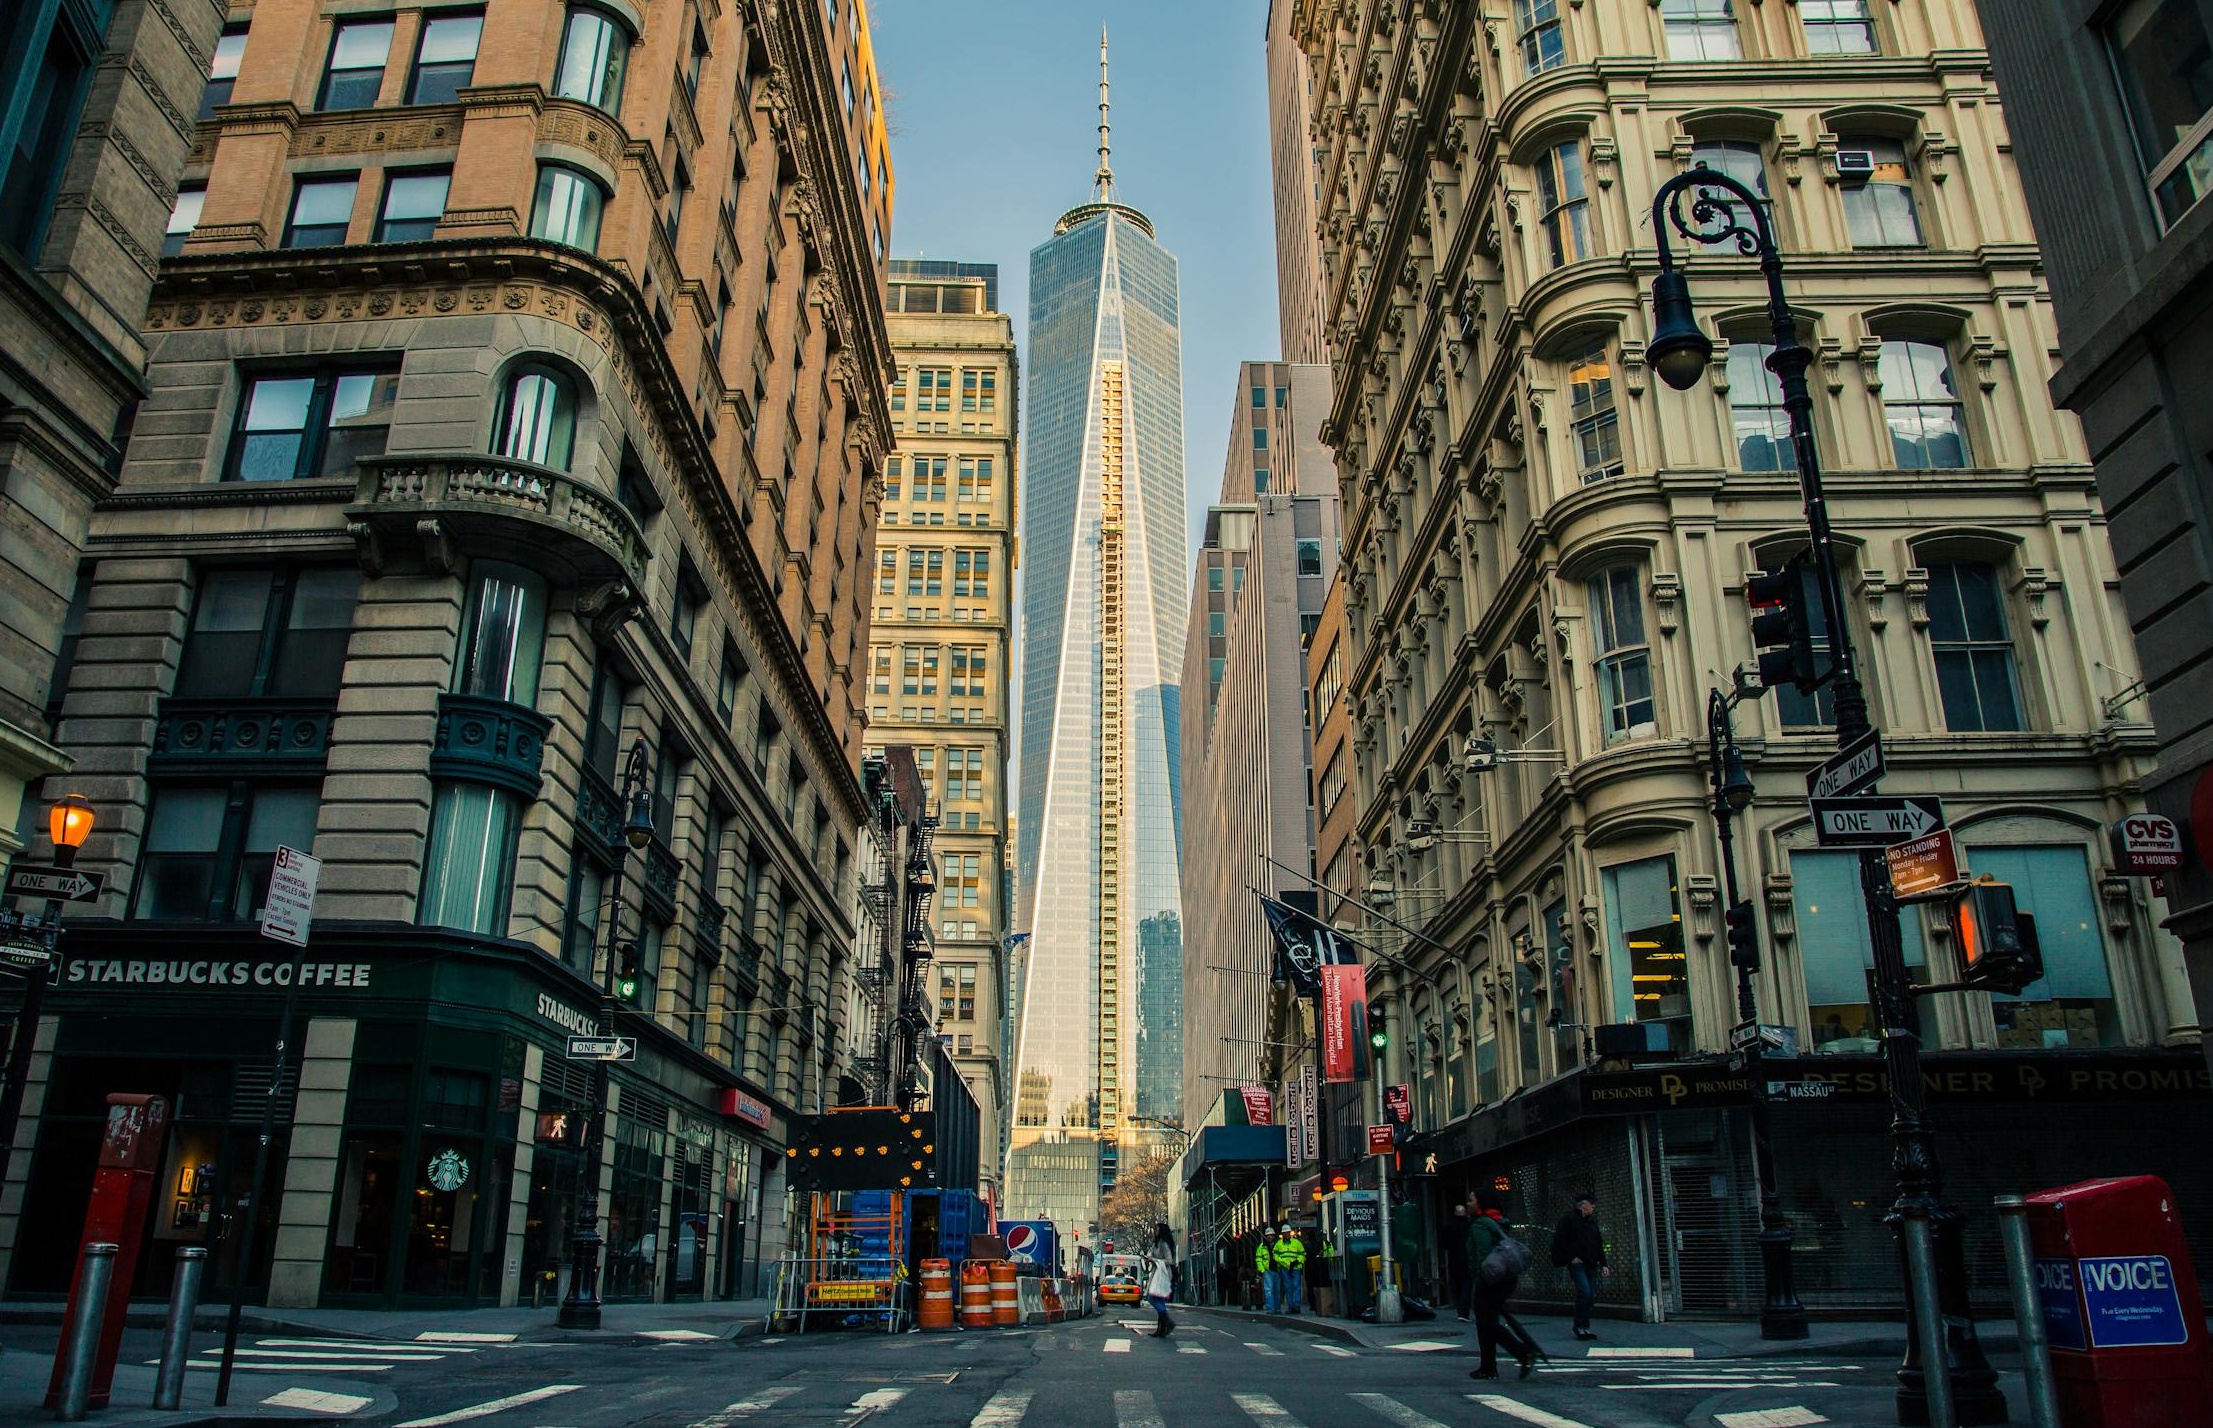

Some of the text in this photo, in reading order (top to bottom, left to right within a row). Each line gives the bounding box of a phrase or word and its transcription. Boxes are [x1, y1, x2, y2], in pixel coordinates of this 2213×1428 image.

[1819, 750, 1872, 797] ONE WAY
[1834, 812, 1923, 832] ONE WAY
[2125, 820, 2174, 839] CVS
[278, 848, 288, 867] 3
[1889, 838, 1941, 860] NO STANDING
[1892, 856, 1914, 871] Monday
[1920, 852, 1938, 863] Friday
[2132, 856, 2178, 864] 24 HOURS
[276, 872, 308, 890] COMMERCIAL
[1911, 866, 1924, 876] 7pm
[20, 874, 88, 892] ONE WAY
[274, 881, 312, 899] VEHICLES ONLY
[2156, 879, 2164, 889] 24
[11, 956, 36, 964] COFFEE
[68, 960, 372, 986] STARBUCKS COFFEE
[538, 992, 594, 1036] STARBUCKS
[1326, 996, 1334, 1035] Manhattan
[578, 1044, 625, 1052] ONE WAY
[1327, 1036, 1337, 1065] Hospital
[1592, 1086, 1653, 1100] DESIGNER
[1696, 1078, 1750, 1093] PROMISE
[2071, 1069, 2210, 1091] PROMIS
[1789, 1086, 1828, 1098] NASSAU
[1305, 1066, 1315, 1157] Lucille Roberts
[1290, 1128, 1298, 1167] Lucille
[2035, 1263, 2073, 1291] OICE
[2088, 1261, 2169, 1292] VOICE
